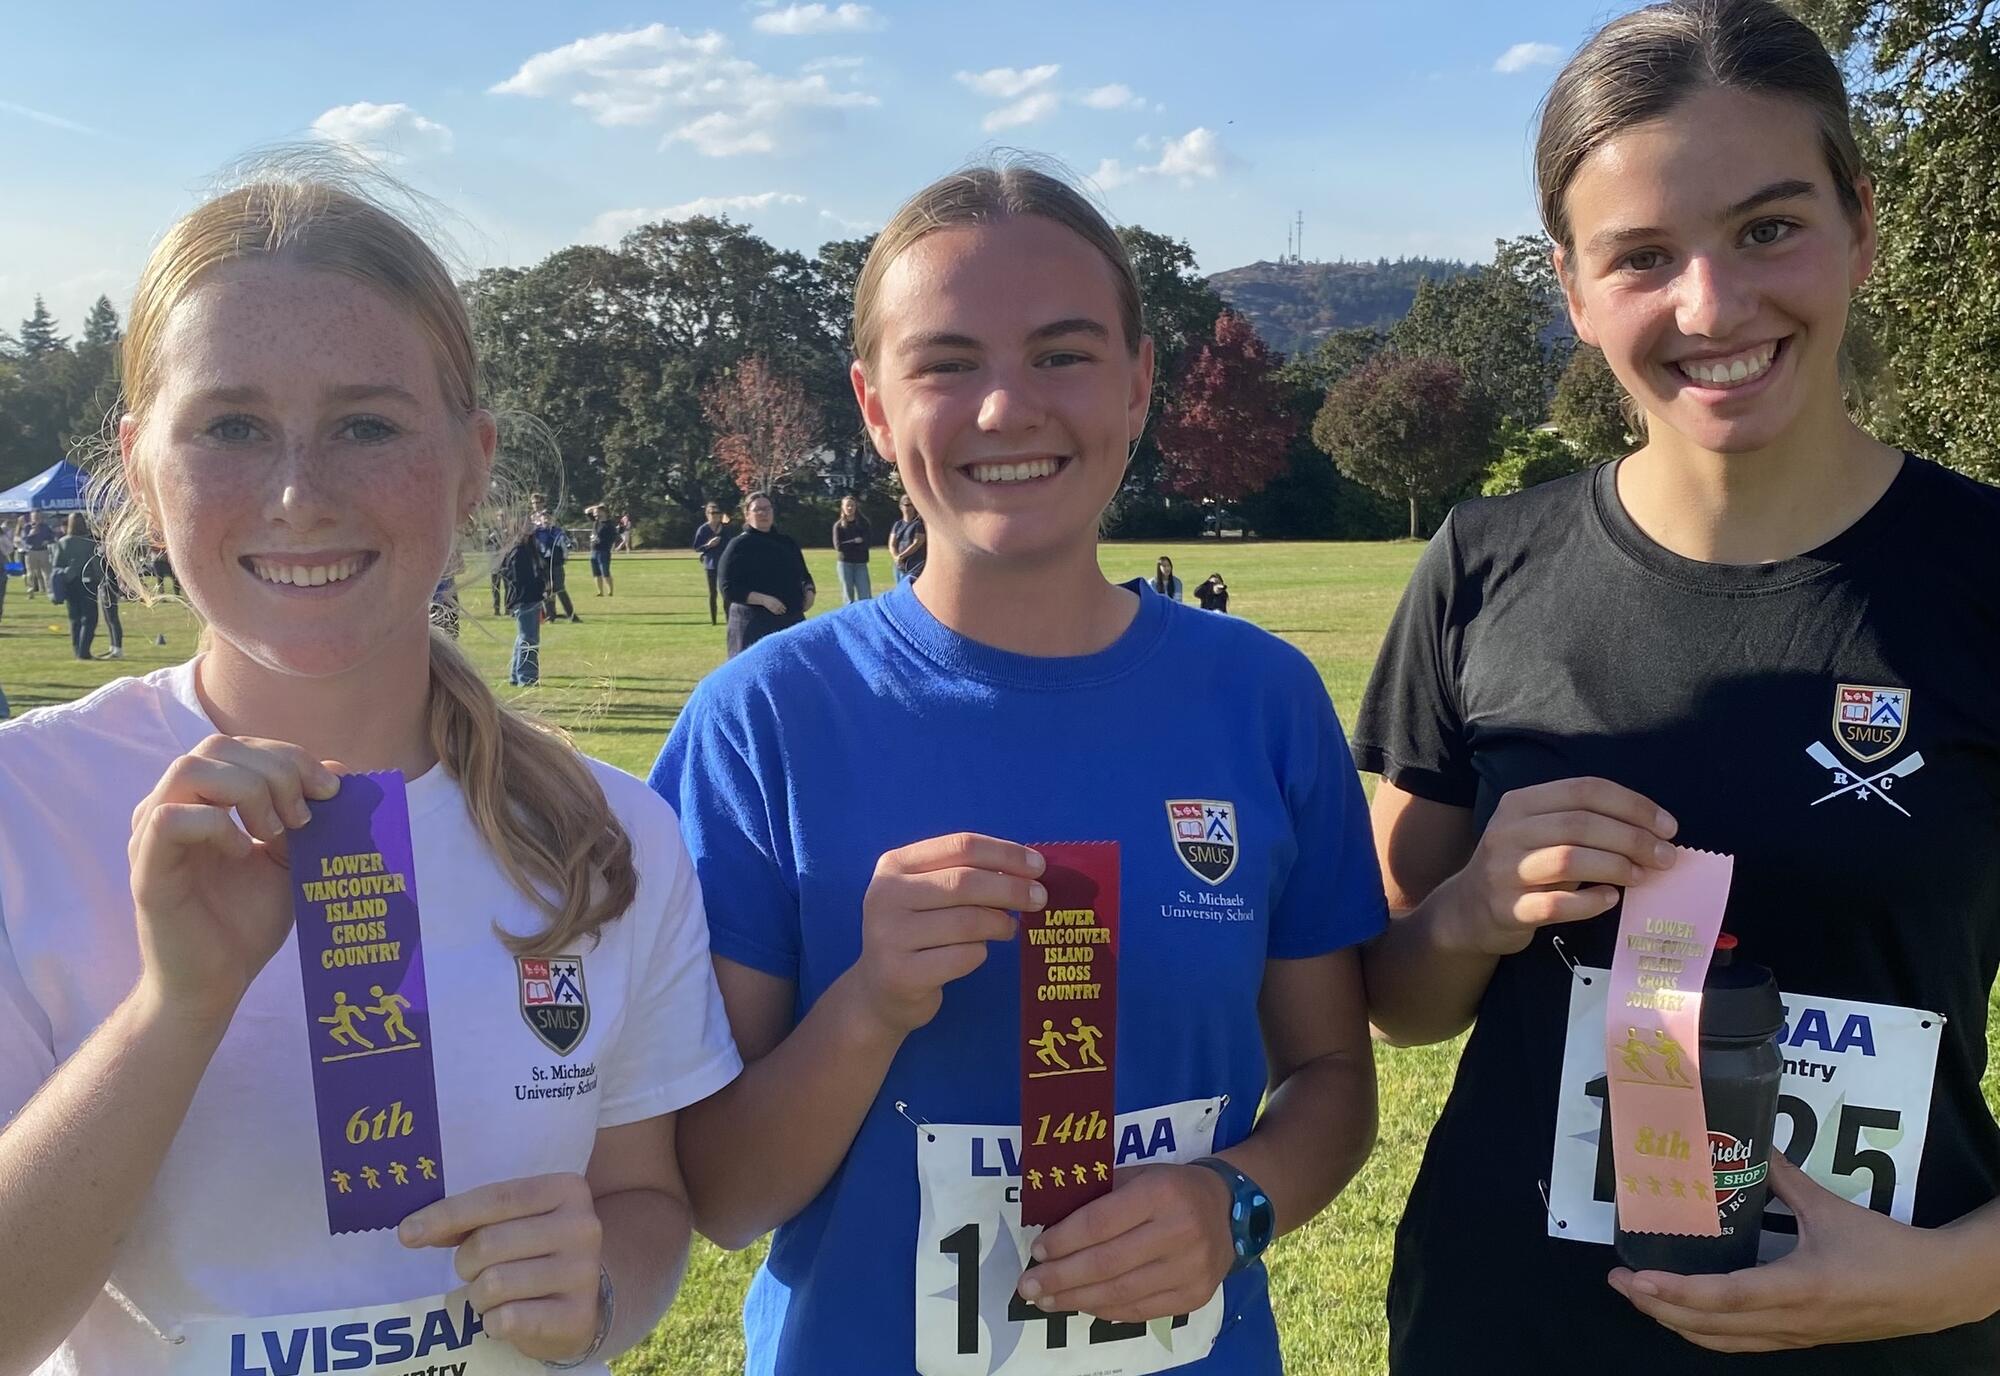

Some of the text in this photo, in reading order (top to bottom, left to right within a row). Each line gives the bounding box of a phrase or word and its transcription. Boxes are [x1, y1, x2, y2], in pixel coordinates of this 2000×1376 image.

[1846, 725, 1893, 744] SMUS
[1833, 772, 1893, 789] R C
[1188, 845, 1230, 865] SMUS
[321, 853, 384, 877] LOWER
[302, 873, 406, 902] VANCOUVER
[1178, 890, 1244, 906] St. Michaels
[325, 898, 388, 923] ISLAND
[1045, 909, 1095, 926] LOWER
[1160, 905, 1254, 923] University School
[332, 921, 386, 945] CROSS
[1028, 928, 1111, 945] VANCOUVER
[321, 941, 400, 969] COUNTRY
[1044, 947, 1094, 963] ISLAND
[1047, 965, 1091, 981] CROSS
[1037, 983, 1101, 1001] COUNTRY
[537, 1009, 580, 1030] SMUS
[532, 1063, 596, 1081] St. Michaels
[514, 1083, 575, 1101] University
[346, 1101, 414, 1144] 6th
[1031, 1110, 1107, 1146] 14th
[1634, 1126, 1690, 1163] 8th
[1723, 1169, 1760, 1185] SHOP
[1729, 1192, 1747, 1212] BC
